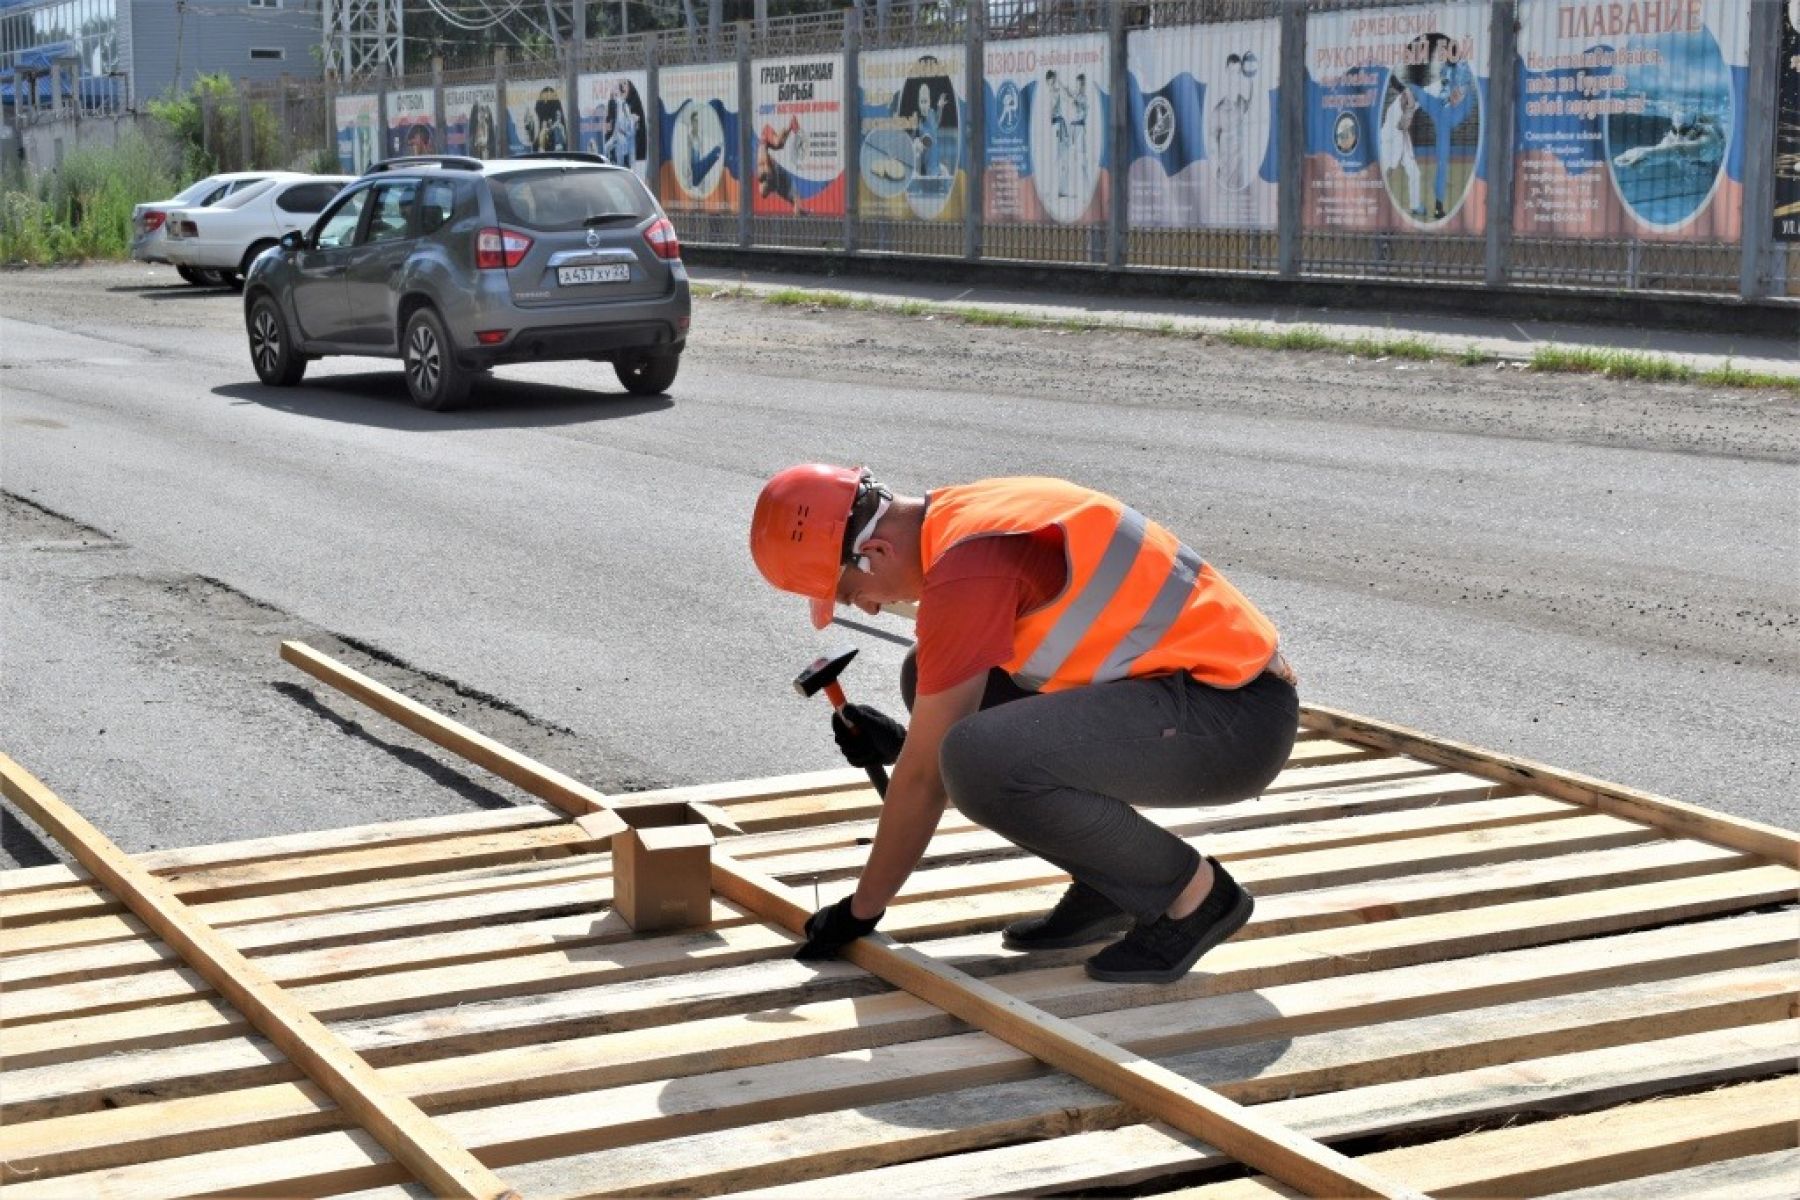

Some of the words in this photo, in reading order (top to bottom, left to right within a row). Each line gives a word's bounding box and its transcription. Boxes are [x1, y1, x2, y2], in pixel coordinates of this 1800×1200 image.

[1352, 10, 1437, 37] АРМЕЙСКИЙ
[1558, 0, 1701, 38] ПЛАВАНИЕ
[987, 50, 1036, 74] ДЗЮДО
[1316, 35, 1430, 67] РУКОПАШНЫЙ
[1437, 33, 1474, 63] БОЙ
[760, 62, 834, 84] ГРЕКО-РИМСКАЯ
[778, 83, 813, 102] БОРЬБА
